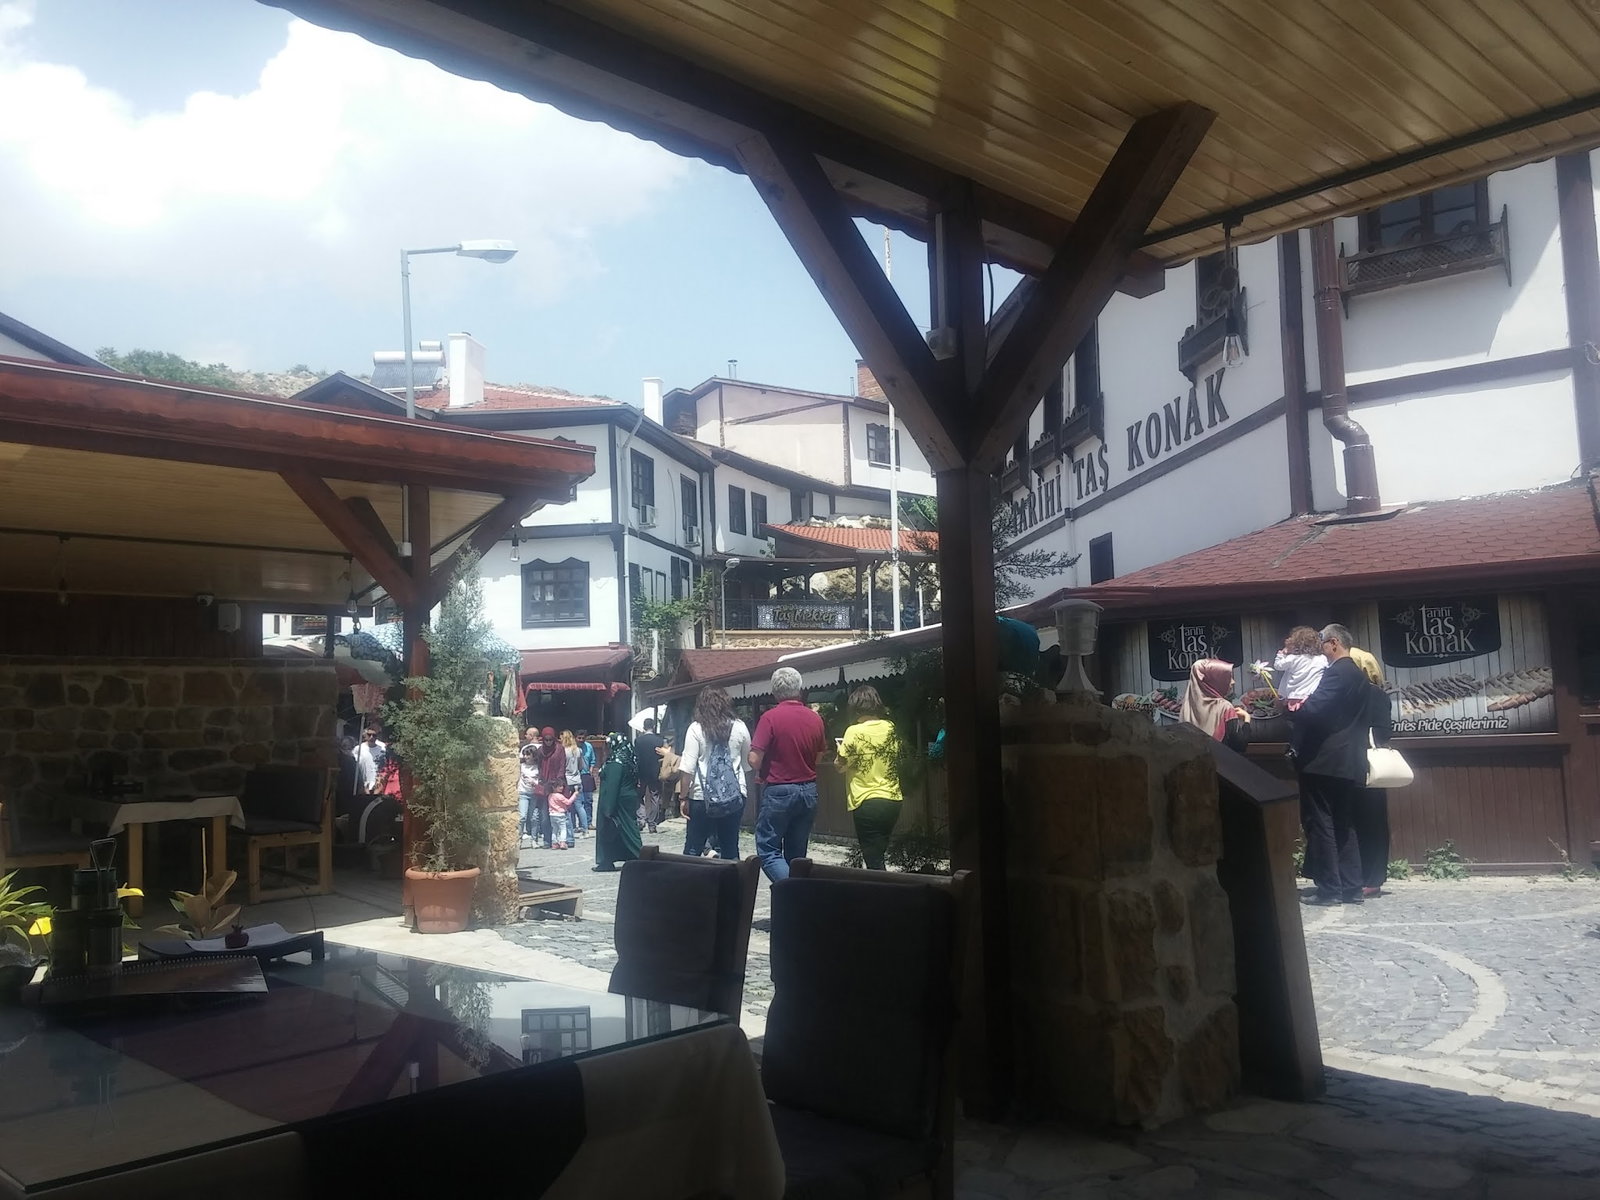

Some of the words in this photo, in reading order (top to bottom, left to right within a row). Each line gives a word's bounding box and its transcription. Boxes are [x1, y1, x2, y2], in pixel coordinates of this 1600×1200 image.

[1072, 443, 1110, 501] TAŞ
[1126, 367, 1230, 472] KONAK
[1417, 718, 1442, 731] Pide
[1443, 716, 1509, 733] Çeşitlerimiz
